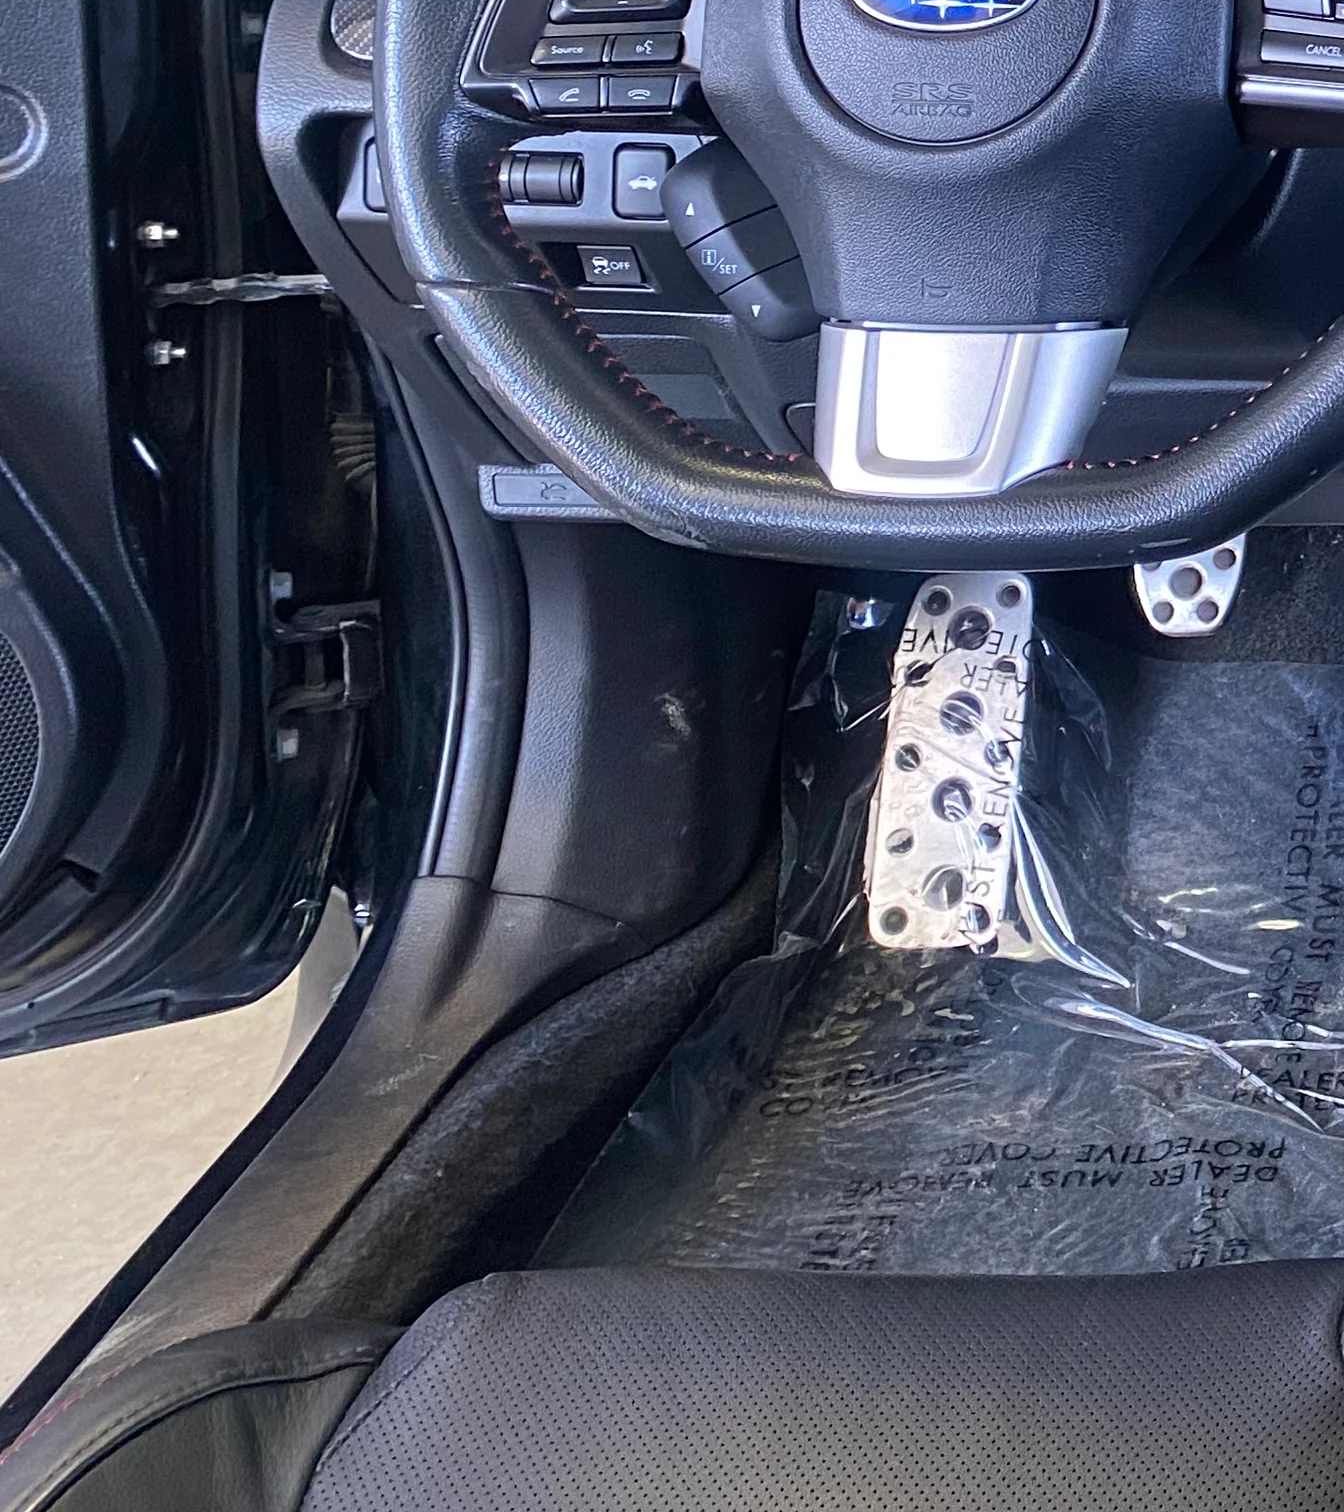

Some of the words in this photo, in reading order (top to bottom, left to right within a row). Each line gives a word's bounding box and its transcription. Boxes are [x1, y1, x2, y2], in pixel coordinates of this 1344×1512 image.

[550, 45, 584, 55] Source
[1305, 44, 1342, 57] CANCEL
[893, 82, 973, 102] SRS
[609, 261, 631, 272] OFF
[1280, 745, 1330, 914] PROTECTIV
[1304, 882, 1344, 964] MUST
[1275, 980, 1324, 1063] REMOE
[1076, 1136, 1286, 1161] PROTECTIVE
[1018, 1169, 1123, 1189] MUST
[1149, 1162, 1279, 1187] DEALER
